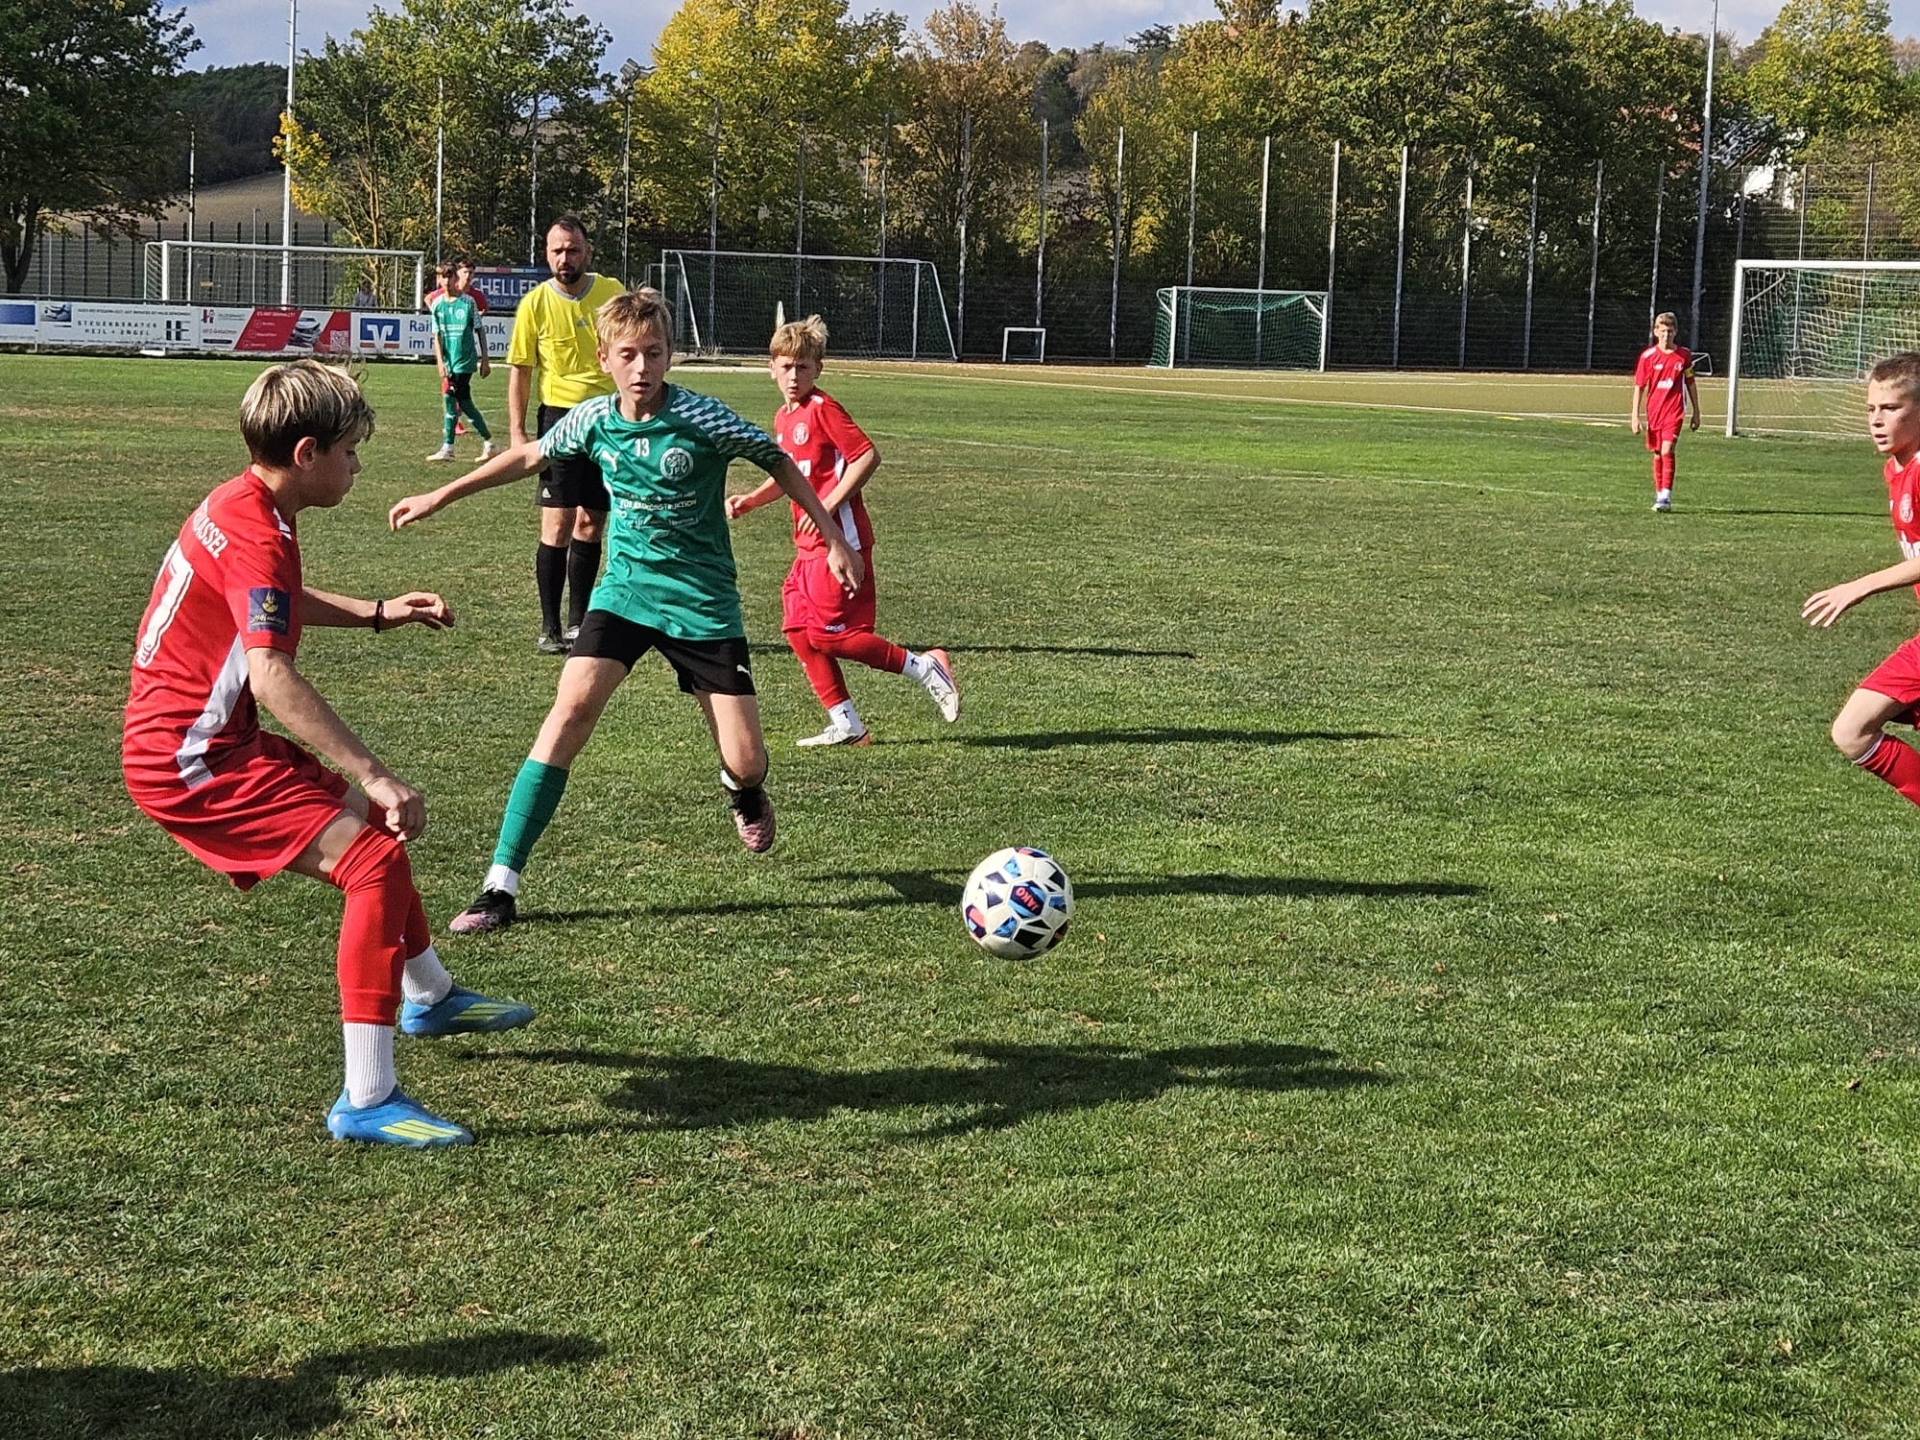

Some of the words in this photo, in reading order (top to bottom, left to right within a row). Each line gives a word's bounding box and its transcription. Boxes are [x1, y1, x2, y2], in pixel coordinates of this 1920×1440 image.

[409, 337, 425, 349] im
[635, 438, 650, 457] 13
[1016, 887, 1039, 911] JAKO
